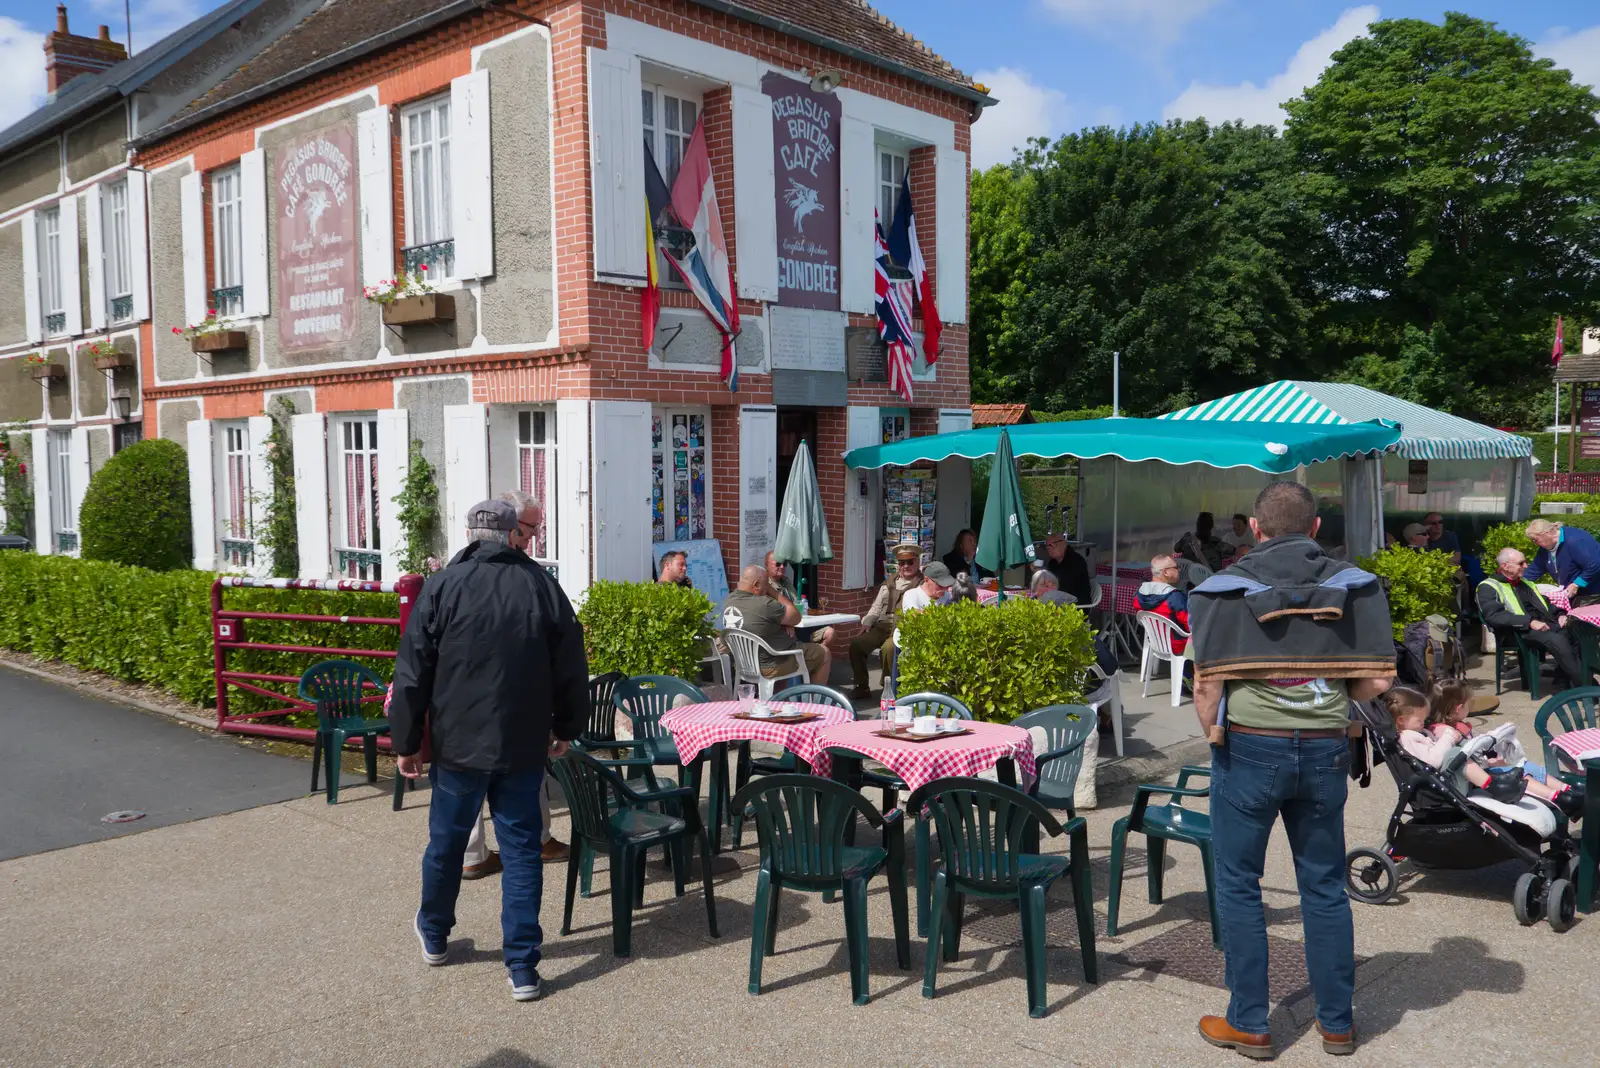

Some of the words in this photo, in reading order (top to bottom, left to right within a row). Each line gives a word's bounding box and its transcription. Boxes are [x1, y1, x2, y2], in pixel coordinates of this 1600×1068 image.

[772, 96, 831, 130] PEGASUS
[787, 119, 835, 162] BRIDGE
[281, 141, 316, 193] PEGASUS
[318, 140, 350, 178] BRIDGE
[783, 238, 805, 255] English
[776, 256, 838, 294] GONDRÉE
